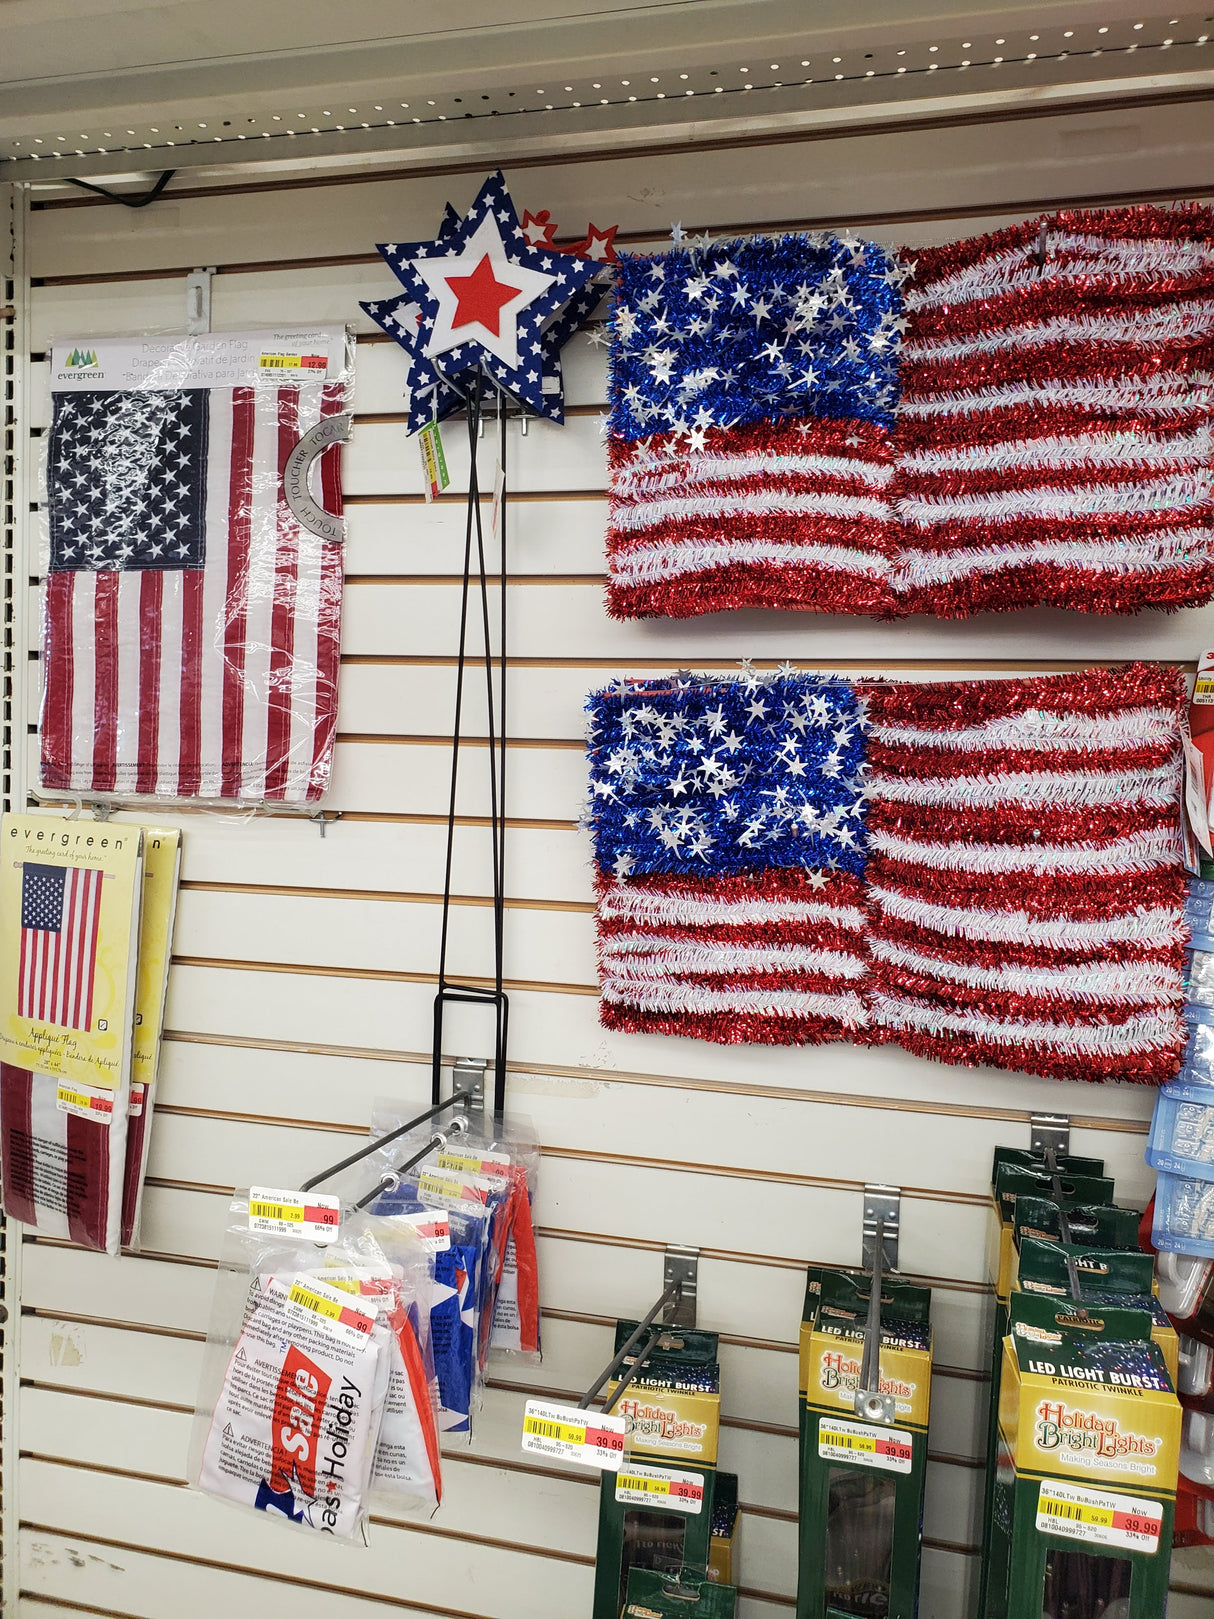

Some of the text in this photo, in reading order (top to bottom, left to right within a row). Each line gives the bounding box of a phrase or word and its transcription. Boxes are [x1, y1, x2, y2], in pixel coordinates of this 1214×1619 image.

[229, 340, 248, 350] Flag
[57, 371, 104, 381] evergreen
[310, 422, 345, 447] TOCAR
[290, 449, 309, 503] TOUCHER
[300, 506, 337, 537] TOUCH
[10, 827, 123, 850] evergreen
[26, 845, 37, 853] The
[29, 1027, 60, 1046] Appliqué
[61, 1034, 77, 1050] Flag
[261, 1194, 282, 1202] American
[321, 1214, 334, 1225] .99
[303, 1283, 323, 1296] American
[325, 1309, 335, 1318] 2.99
[354, 1321, 368, 1333] .99
[262, 1320, 272, 1330] bag
[272, 1324, 283, 1333] and
[282, 1329, 293, 1337] any
[292, 1332, 308, 1341] other
[308, 1337, 330, 1351] packing
[330, 1345, 356, 1358] materials
[325, 1334, 336, 1344] bag
[821, 1325, 921, 1349] LED BURST
[335, 1354, 343, 1363] Do
[343, 1359, 354, 1367] not
[1028, 1360, 1160, 1390] LED LIGHT BURST
[618, 1374, 711, 1393] LD LIGHT BURST
[631, 1384, 665, 1393] PATRIOTIC
[878, 1378, 911, 1397] ights
[1051, 1377, 1144, 1397] PATRIOTIC TWINKLE
[280, 1368, 319, 1462] sale
[620, 1400, 675, 1424] Holiday
[1039, 1402, 1116, 1435] Holiday
[321, 1375, 362, 1483] Holiday
[601, 1424, 615, 1433] Now
[596, 1436, 623, 1451] 39.99
[635, 1437, 701, 1451] Making Seasons Bright
[885, 1446, 910, 1459] 39.99
[1060, 1453, 1155, 1474] Making Seasons Bright
[678, 1487, 701, 1499] 39.99
[1041, 1487, 1075, 1501] 36"140LTw
[1131, 1507, 1148, 1516] Now
[1091, 1515, 1108, 1524] 59.99
[1124, 1518, 1158, 1534] 39.99
